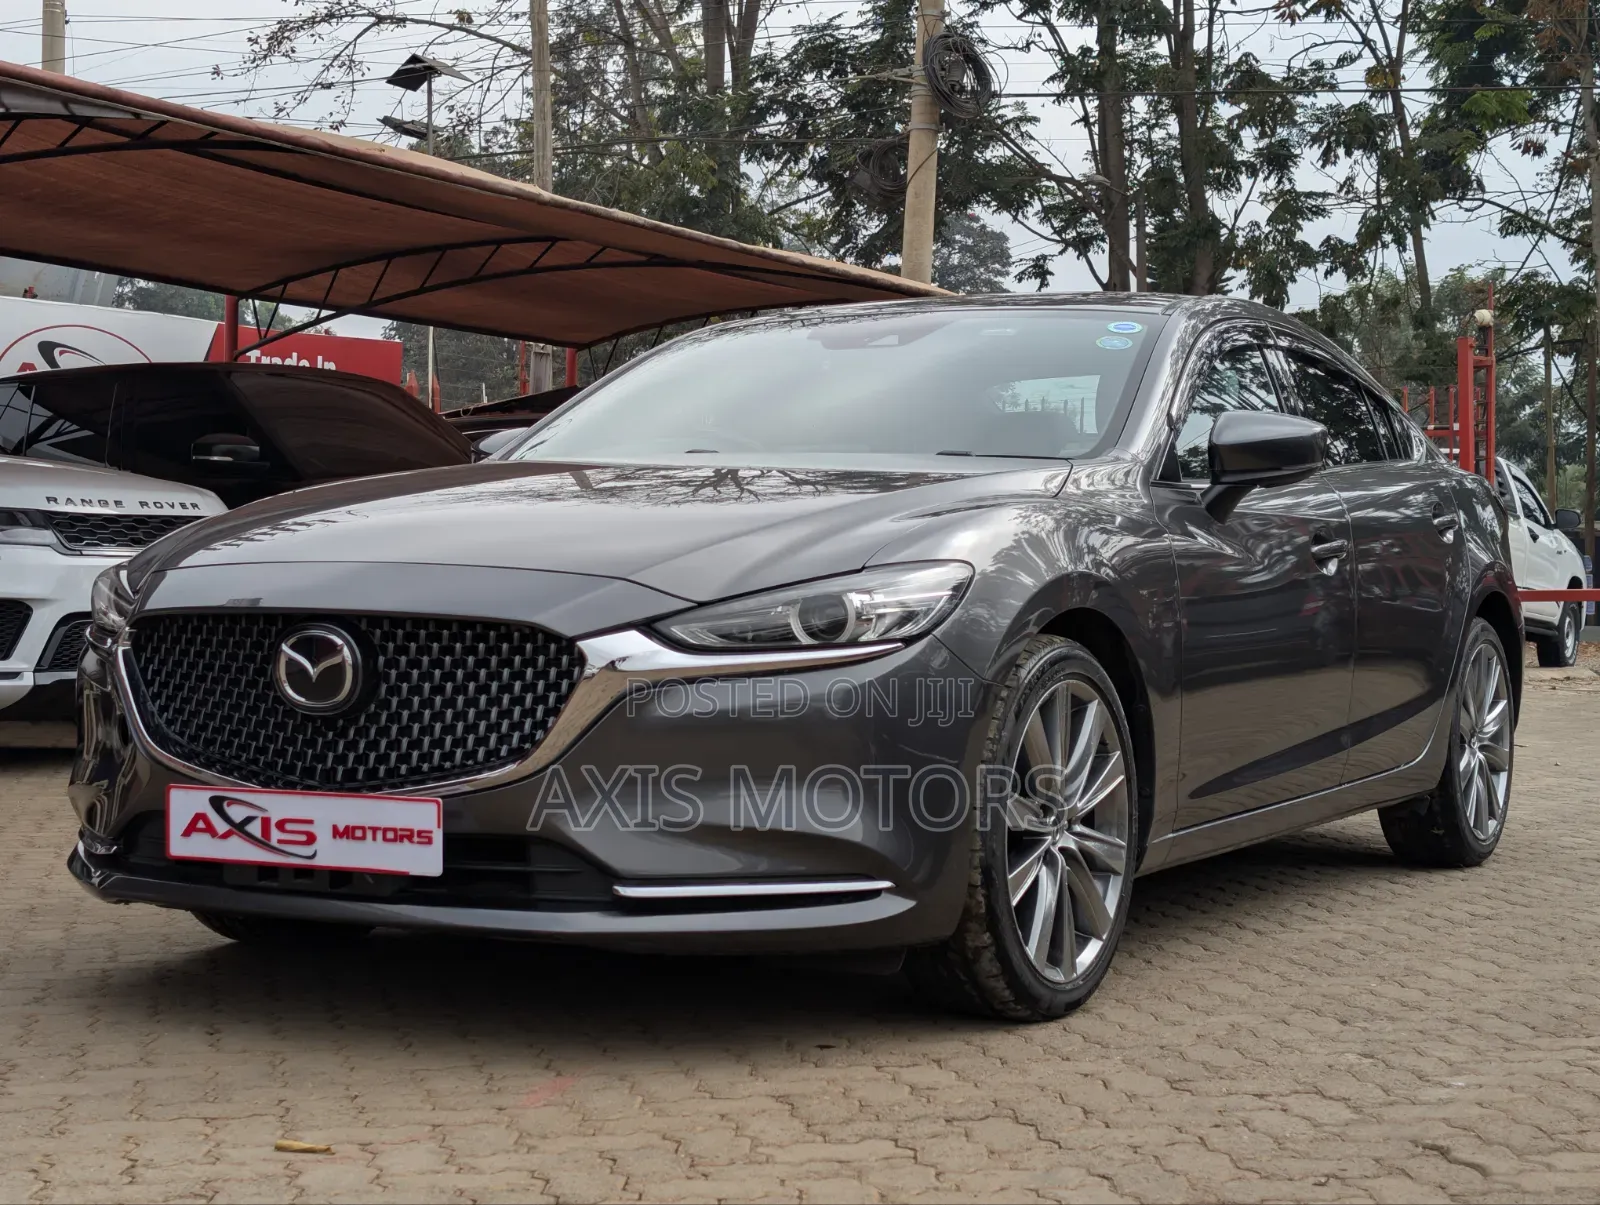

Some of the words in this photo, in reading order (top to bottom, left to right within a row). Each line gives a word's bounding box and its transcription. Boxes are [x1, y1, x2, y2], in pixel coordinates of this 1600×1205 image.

[45, 496, 126, 508] RANGE
[138, 500, 201, 510] ROVER
[181, 798, 317, 856] AXIS
[333, 824, 433, 845] MOTORS
